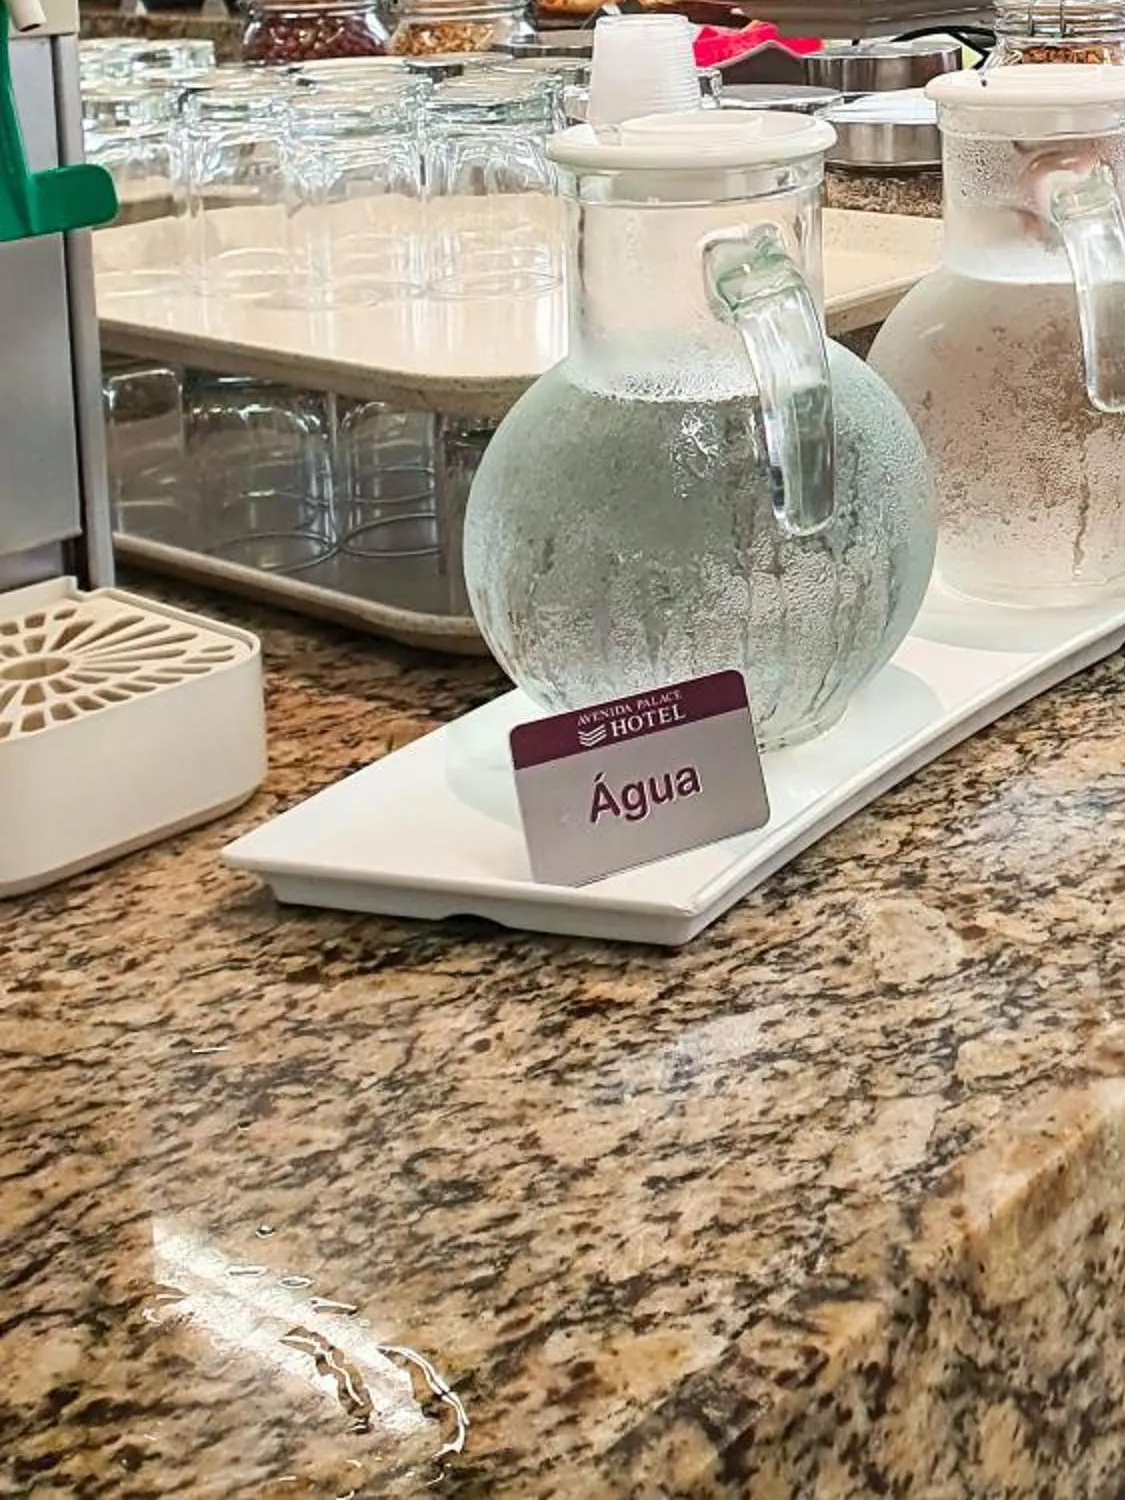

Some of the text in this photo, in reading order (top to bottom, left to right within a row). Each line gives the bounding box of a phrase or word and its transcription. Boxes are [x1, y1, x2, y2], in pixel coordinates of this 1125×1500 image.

[577, 690, 682, 726] AVENIDA PALACE
[610, 703, 686, 737] HOTEL
[589, 766, 701, 824] Água
